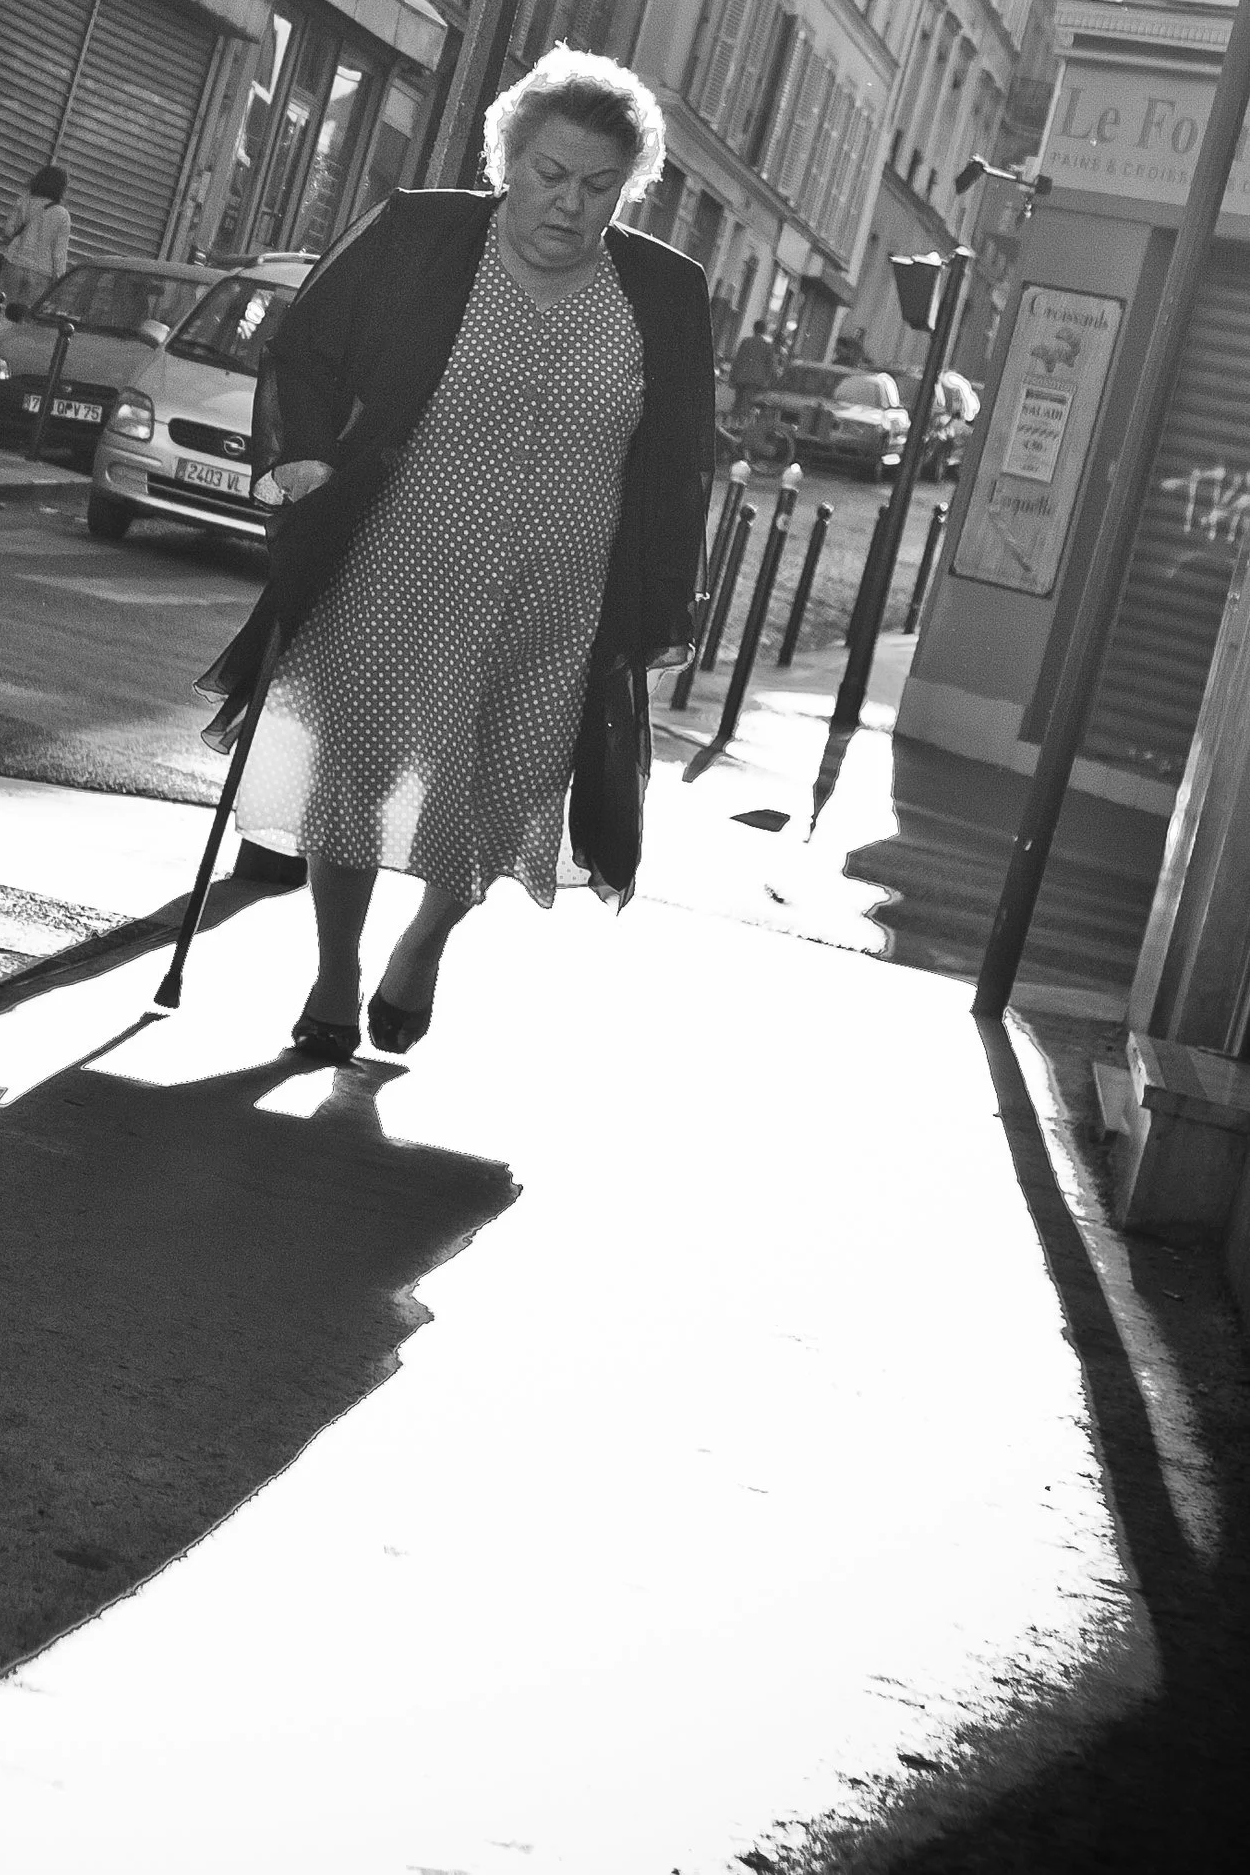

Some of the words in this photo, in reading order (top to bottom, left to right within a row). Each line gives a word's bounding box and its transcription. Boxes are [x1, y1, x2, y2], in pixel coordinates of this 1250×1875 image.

[1056, 86, 1121, 144] Le
[1134, 97, 1199, 156] Fo
[1122, 160, 1189, 185] CROISS
[187, 463, 223, 488] 2403
